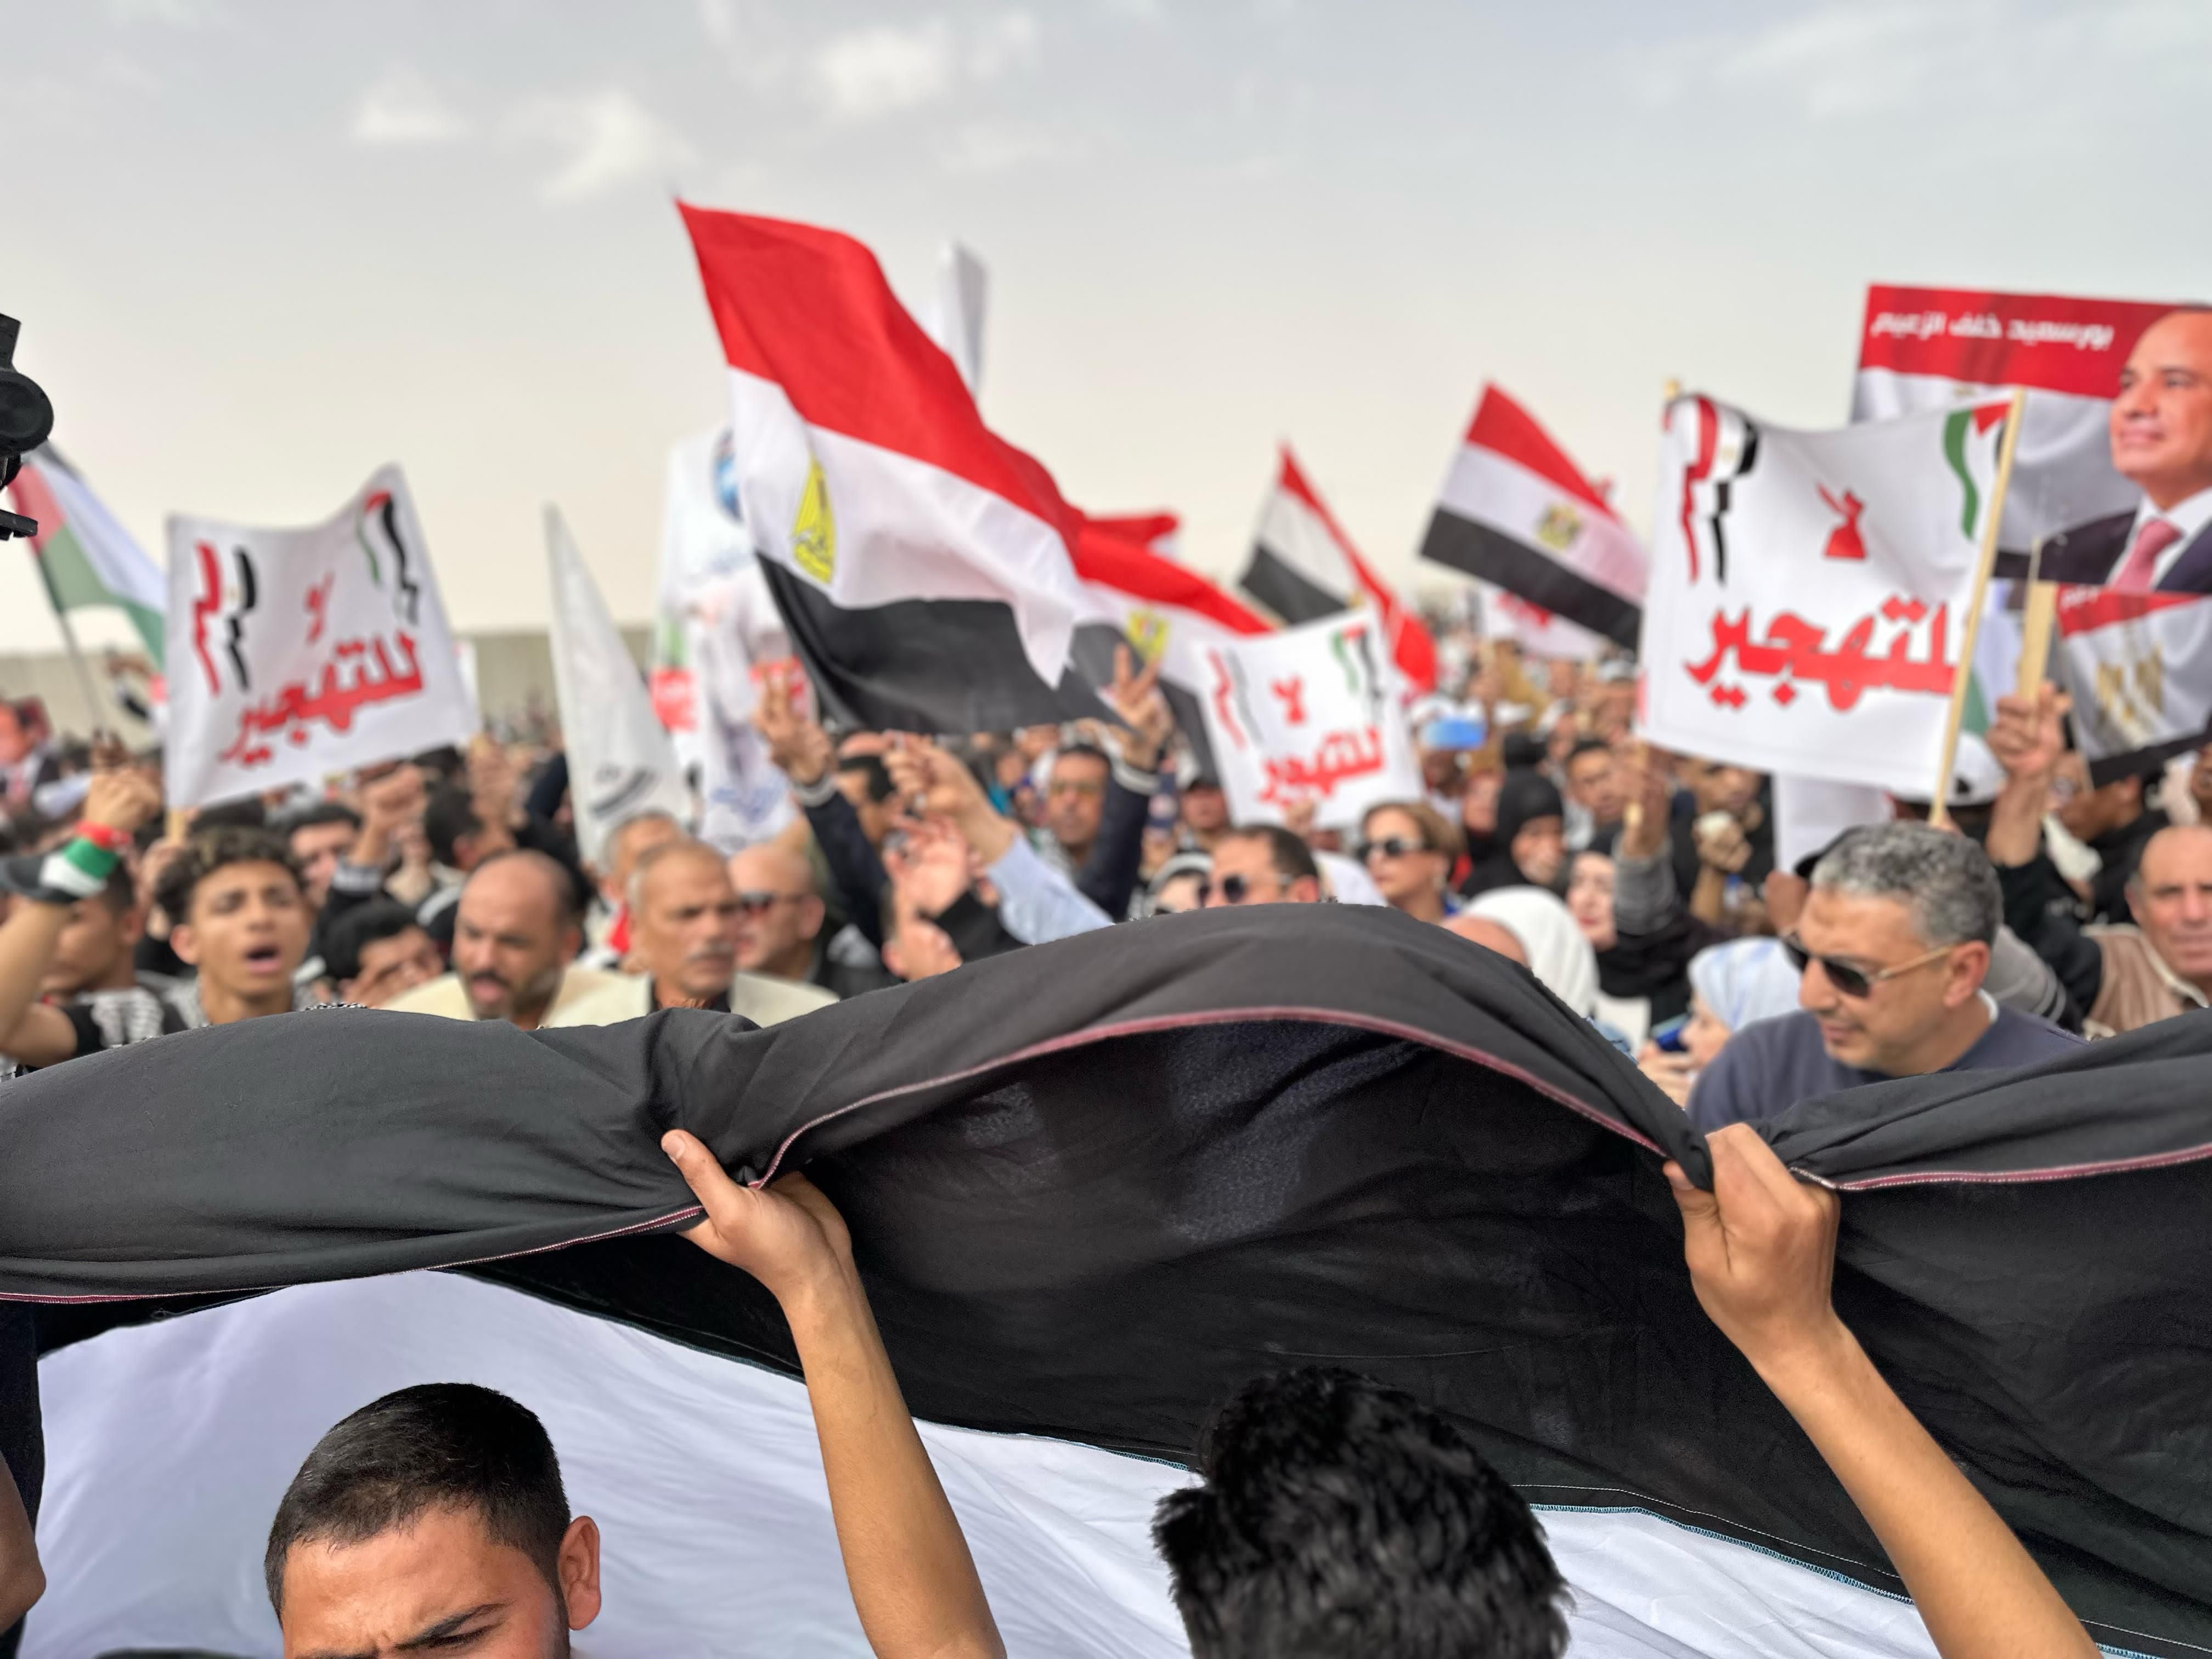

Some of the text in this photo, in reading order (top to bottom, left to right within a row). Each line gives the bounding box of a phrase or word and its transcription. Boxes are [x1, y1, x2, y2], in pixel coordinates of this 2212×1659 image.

[1816, 483, 1866, 559] لا
[219, 630, 424, 764] للتهجير
[1271, 675, 1306, 725] لا
[1683, 594, 1959, 714] لتهجير
